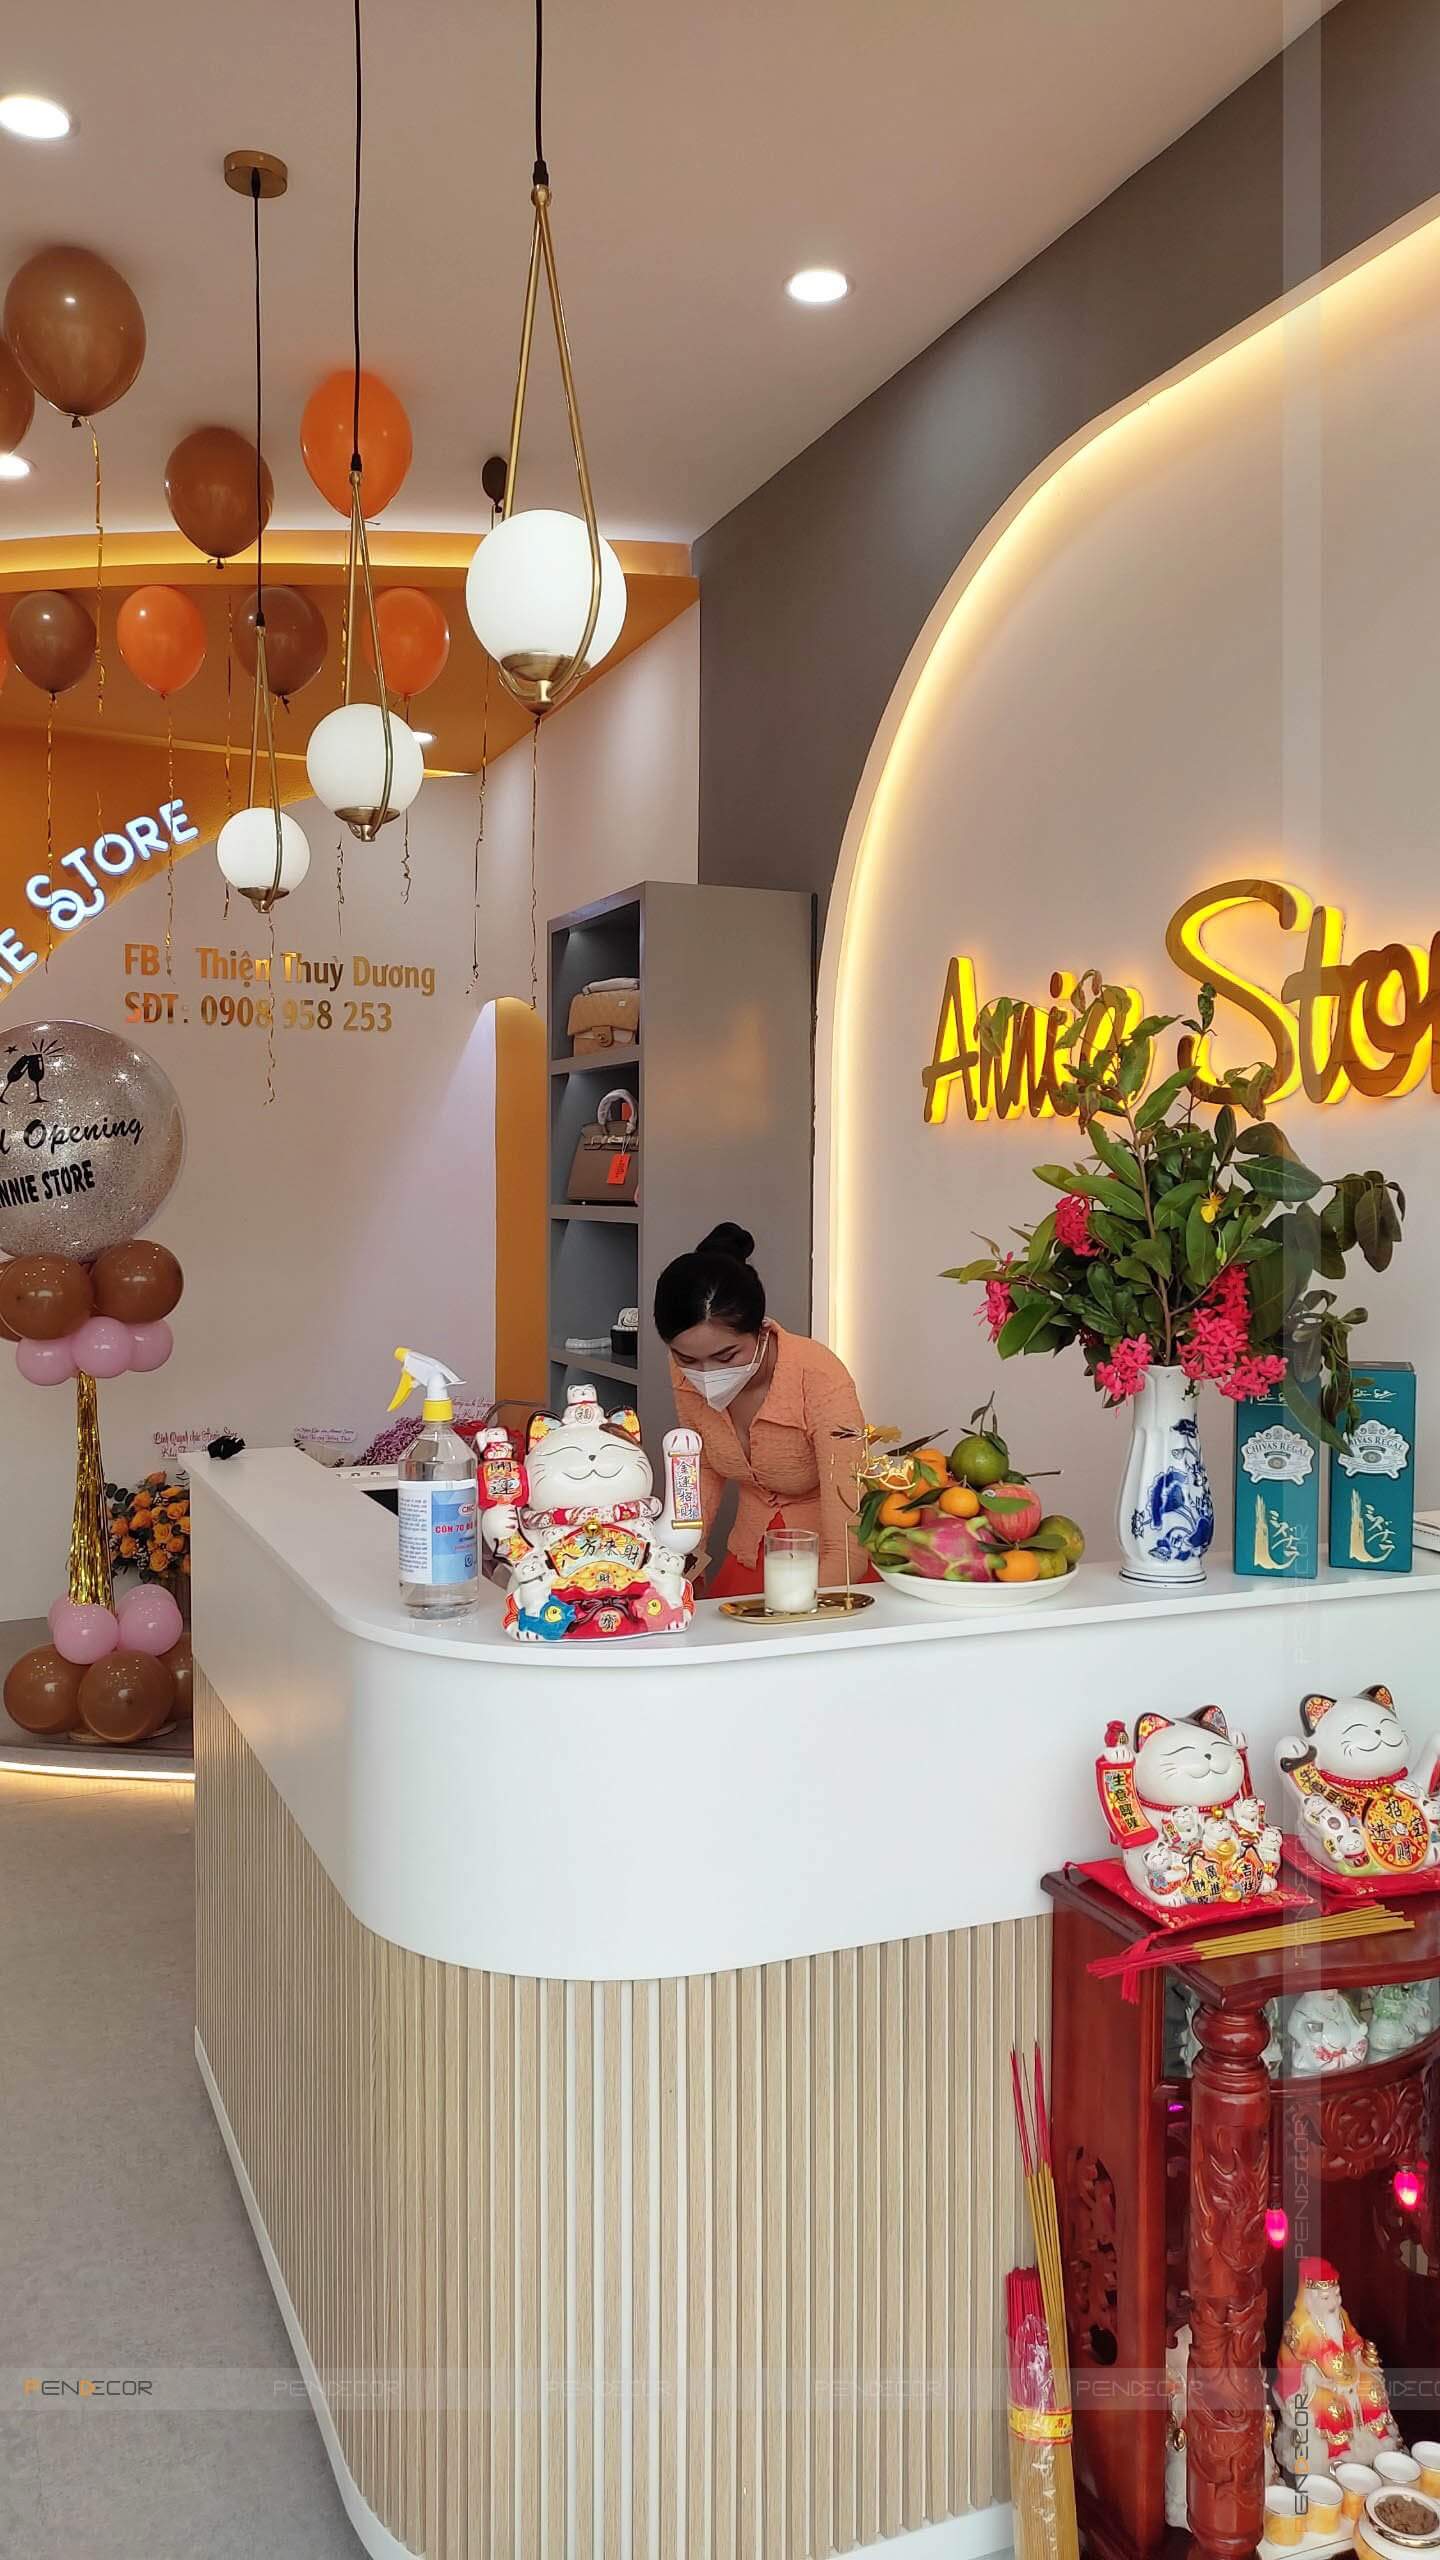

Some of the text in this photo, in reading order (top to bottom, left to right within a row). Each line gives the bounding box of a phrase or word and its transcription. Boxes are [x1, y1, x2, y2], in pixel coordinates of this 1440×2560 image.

[26, 799, 199, 930] STORE
[196, 947, 271, 988] Thiện
[353, 955, 435, 996] Dương
[200, 994, 272, 1027] 0908
[282, 998, 333, 1032] 958
[343, 1001, 393, 1033] 253
[24, 1118, 144, 1155] Opening
[41, 1159, 96, 1199] STORE
[1350, 1436, 1373, 1447] HIVAS
